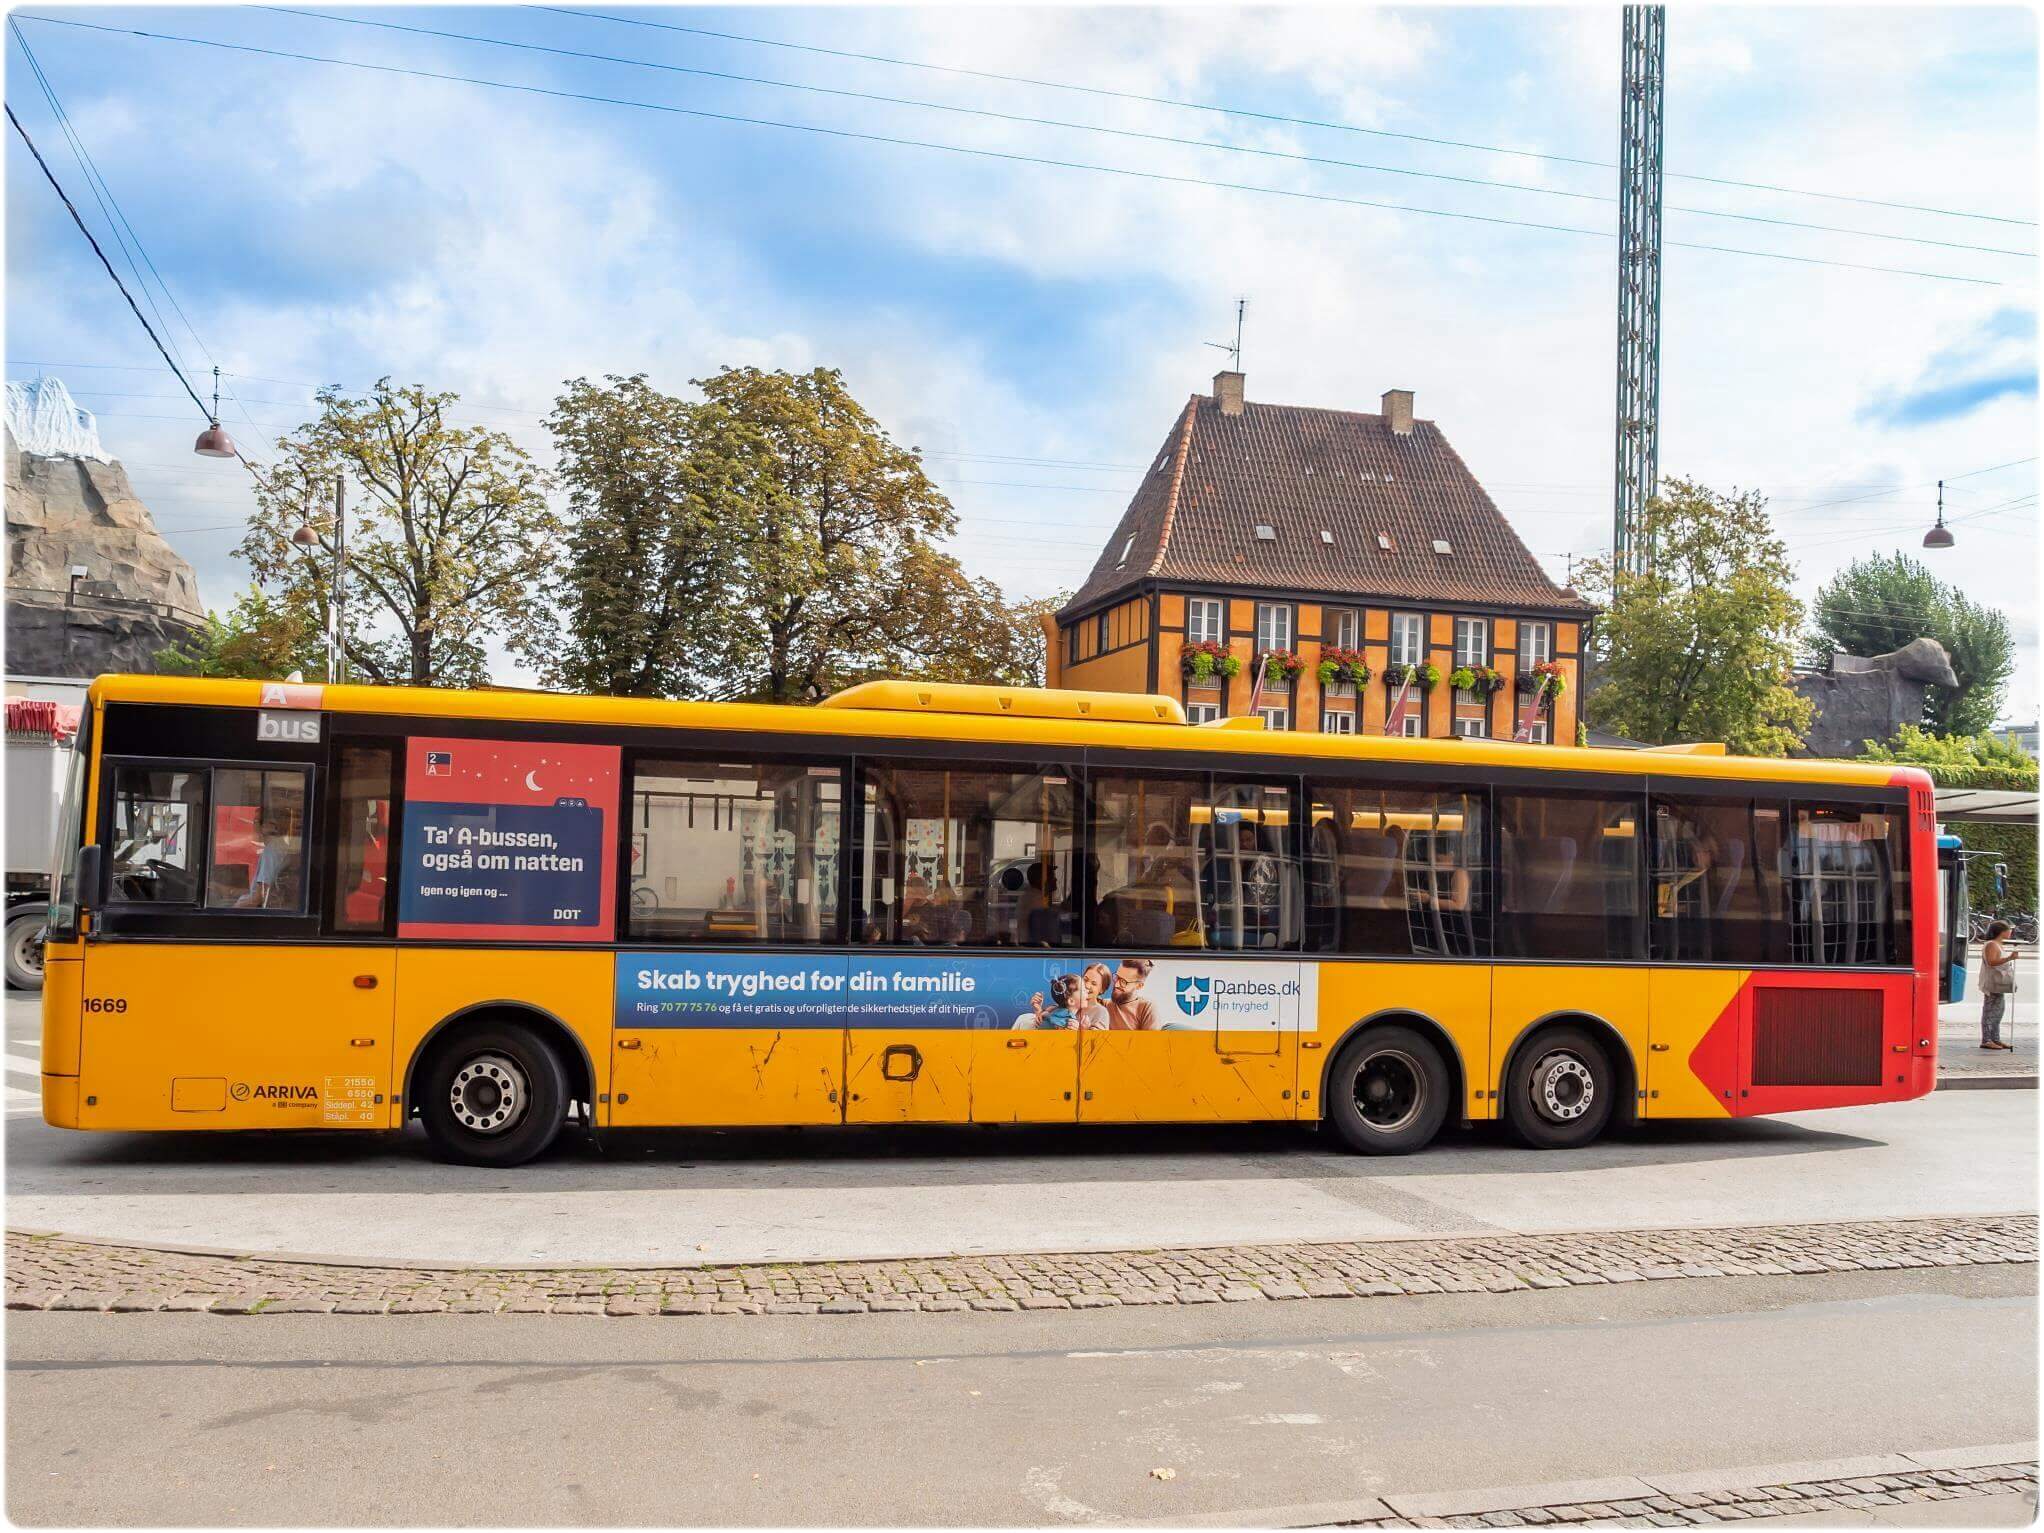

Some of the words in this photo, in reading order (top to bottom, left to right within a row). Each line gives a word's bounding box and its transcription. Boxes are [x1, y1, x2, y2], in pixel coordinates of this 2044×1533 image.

[262, 685, 288, 705] A
[259, 713, 318, 740] bus
[429, 753, 437, 764] 2
[428, 764, 437, 776] A
[457, 827, 559, 850] A-bussen,
[422, 849, 473, 872] også
[477, 855, 510, 870] om
[514, 854, 584, 872] natten
[420, 885, 443, 897] Igen
[445, 887, 459, 898] og
[460, 886, 482, 897] igen
[484, 888, 498, 898] og
[553, 909, 581, 920] DOT
[637, 970, 701, 990] Skab
[705, 970, 806, 997] tryghed
[810, 971, 846, 991] for
[850, 971, 888, 992] din
[892, 971, 976, 992] familie
[1213, 979, 1300, 996] Danbes.dk
[84, 998, 128, 1014] 1669
[636, 1002, 659, 1014] Ring
[660, 1002, 673, 1012] 70
[675, 1002, 688, 1012] 77
[690, 1003, 702, 1013] 75
[705, 1003, 717, 1013] 76
[718, 1005, 731, 1014] og
[732, 1003, 742, 1013] få
[743, 1004, 754, 1013] et
[755, 1003, 782, 1014] gratis
[783, 1005, 795, 1015] og
[797, 1003, 859, 1015] uforpligtende
[860, 1004, 927, 1015] sikkerhedstjek
[928, 1004, 938, 1014] af
[939, 1004, 951, 1014] dit
[952, 1005, 975, 1016] hjem
[1212, 1001, 1229, 1010] Din
[1232, 1001, 1269, 1013] tryghed
[253, 1085, 319, 1099] ARRIVA
[360, 1100, 374, 1109] 42
[359, 1112, 373, 1121] 40
